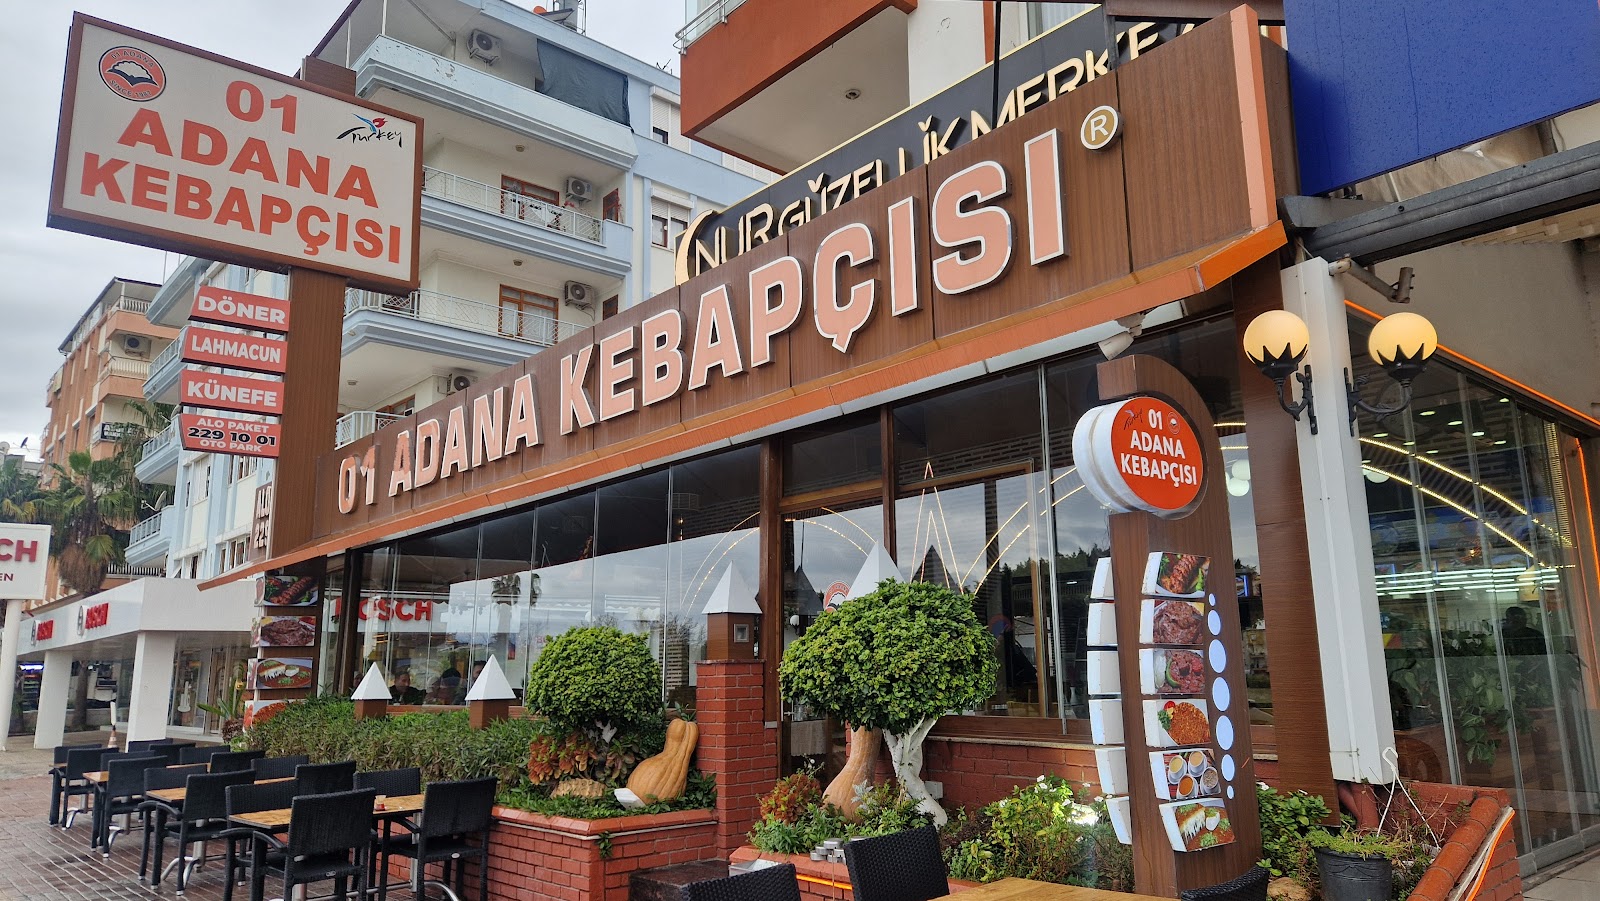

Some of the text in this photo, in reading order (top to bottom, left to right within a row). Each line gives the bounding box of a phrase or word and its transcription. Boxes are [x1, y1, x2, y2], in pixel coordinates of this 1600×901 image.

[123, 50, 154, 68] ADANA
[110, 80, 132, 97] SINCE
[226, 80, 298, 135] 01
[117, 107, 379, 209] ADANA
[696, 203, 775, 277] NUR
[971, 21, 1196, 141] MERKE
[80, 152, 401, 264] KEBAPÇISI
[198, 295, 286, 324] DÖNER
[338, 443, 377, 515] 01
[388, 373, 540, 498] ADANA
[560, 128, 1064, 437] KEBAPÇISI
[192, 335, 281, 364] LAHMACUN
[187, 379, 277, 407] KÜNEFE
[197, 418, 269, 433] ALO PAKET
[1148, 408, 1163, 430] 01
[187, 427, 276, 446] 229 10 01
[200, 439, 262, 452] OTO PARK
[1130, 429, 1186, 459] ADANA
[1120, 452, 1197, 487] KEBAPÇISI
